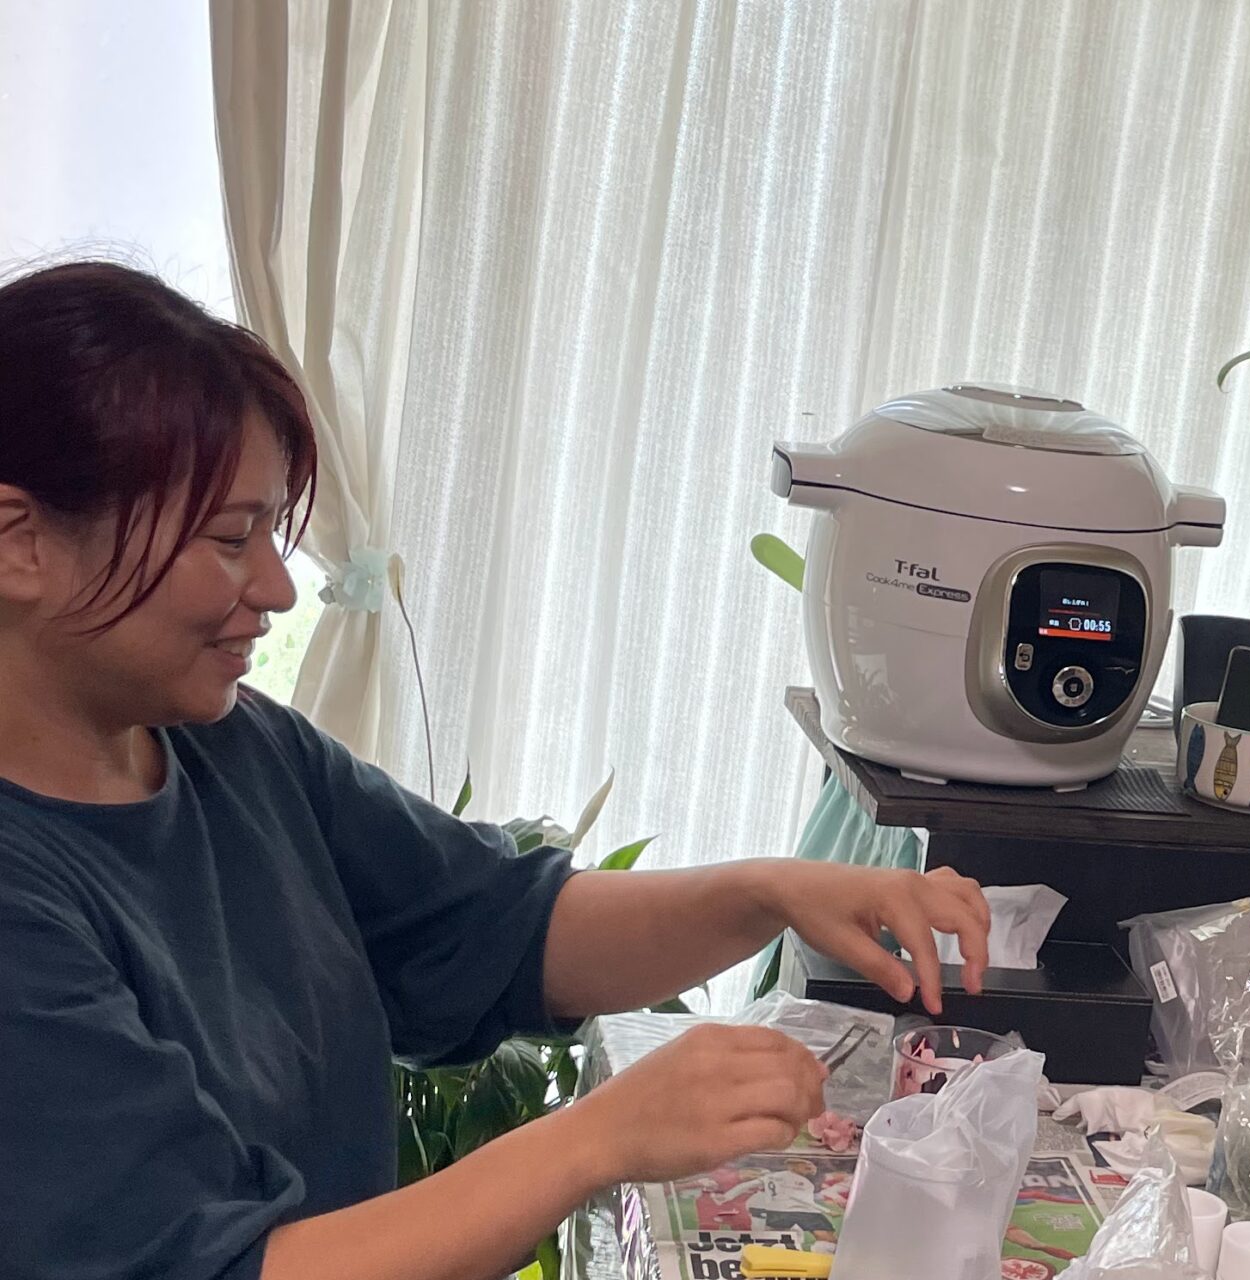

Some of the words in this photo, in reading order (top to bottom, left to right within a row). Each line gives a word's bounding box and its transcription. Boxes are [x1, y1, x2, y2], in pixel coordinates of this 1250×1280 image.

[895, 559, 940, 581] T-fal
[919, 583, 969, 601] Express
[1084, 619, 1111, 632] 00:55
